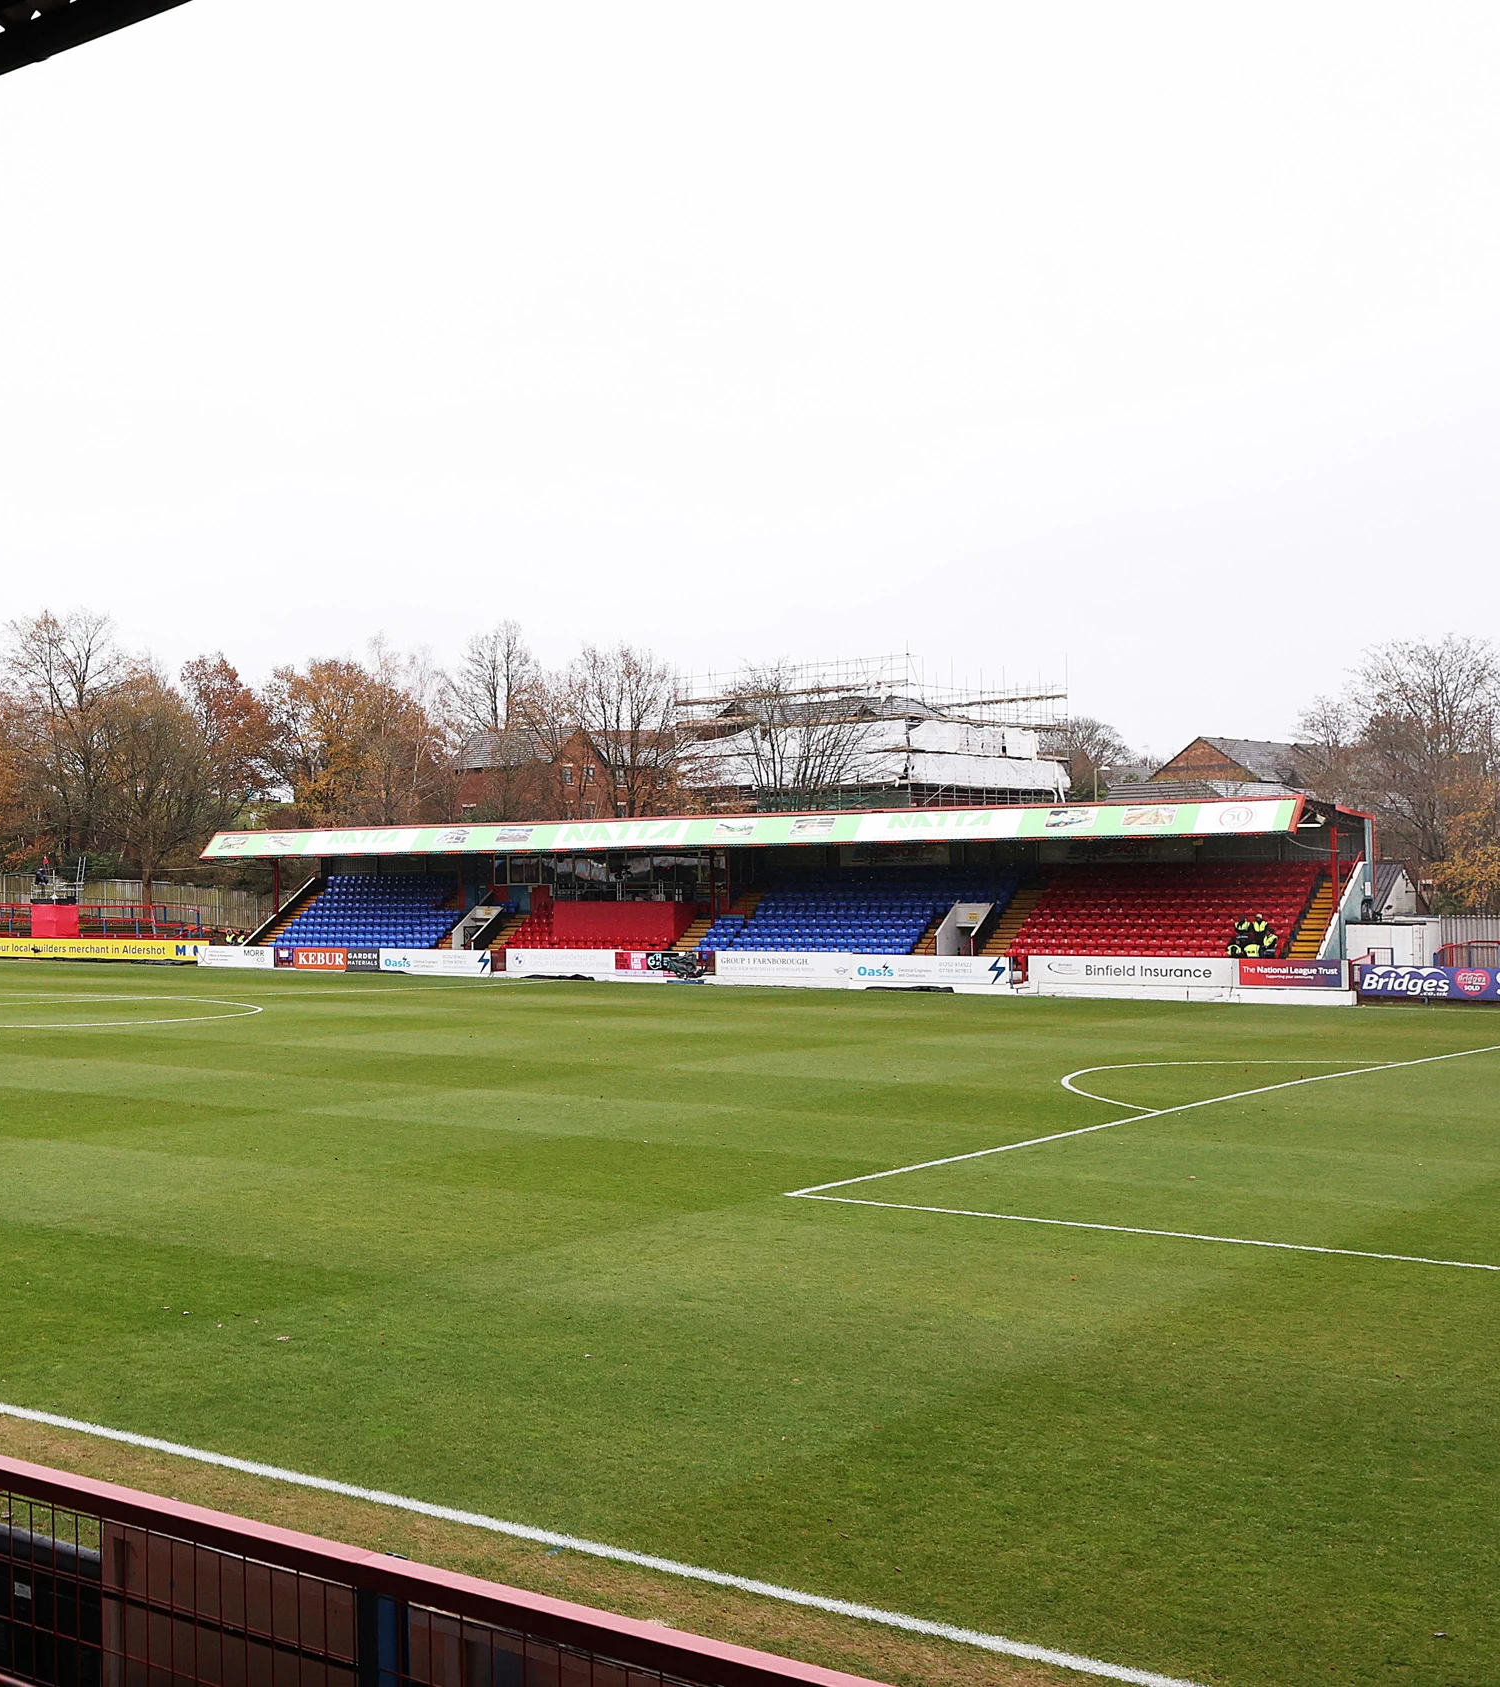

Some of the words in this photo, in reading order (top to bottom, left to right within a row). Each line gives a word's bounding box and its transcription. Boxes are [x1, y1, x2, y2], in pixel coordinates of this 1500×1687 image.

[887, 811, 993, 829] NATTA
[327, 831, 401, 844] NATTA
[562, 822, 682, 842] NATTA
[11, 942, 32, 952] local
[68, 944, 109, 954] merchant
[111, 945, 120, 954] in
[122, 945, 166, 955] Aldershot
[243, 949, 265, 957] MORR
[297, 952, 344, 966] KEBUR
[384, 957, 411, 968] Oasis
[720, 957, 746, 965] GROUP
[753, 957, 810, 966] FARNBOROUGH.
[857, 963, 894, 977] Oasis
[1085, 964, 1136, 977] Binfield
[1140, 965, 1213, 978] Insurance
[1243, 966, 1256, 974] The
[1257, 966, 1289, 975] National
[1290, 967, 1317, 976] League
[1362, 972, 1450, 996] Bridges
[1457, 974, 1486, 984] Bridges
